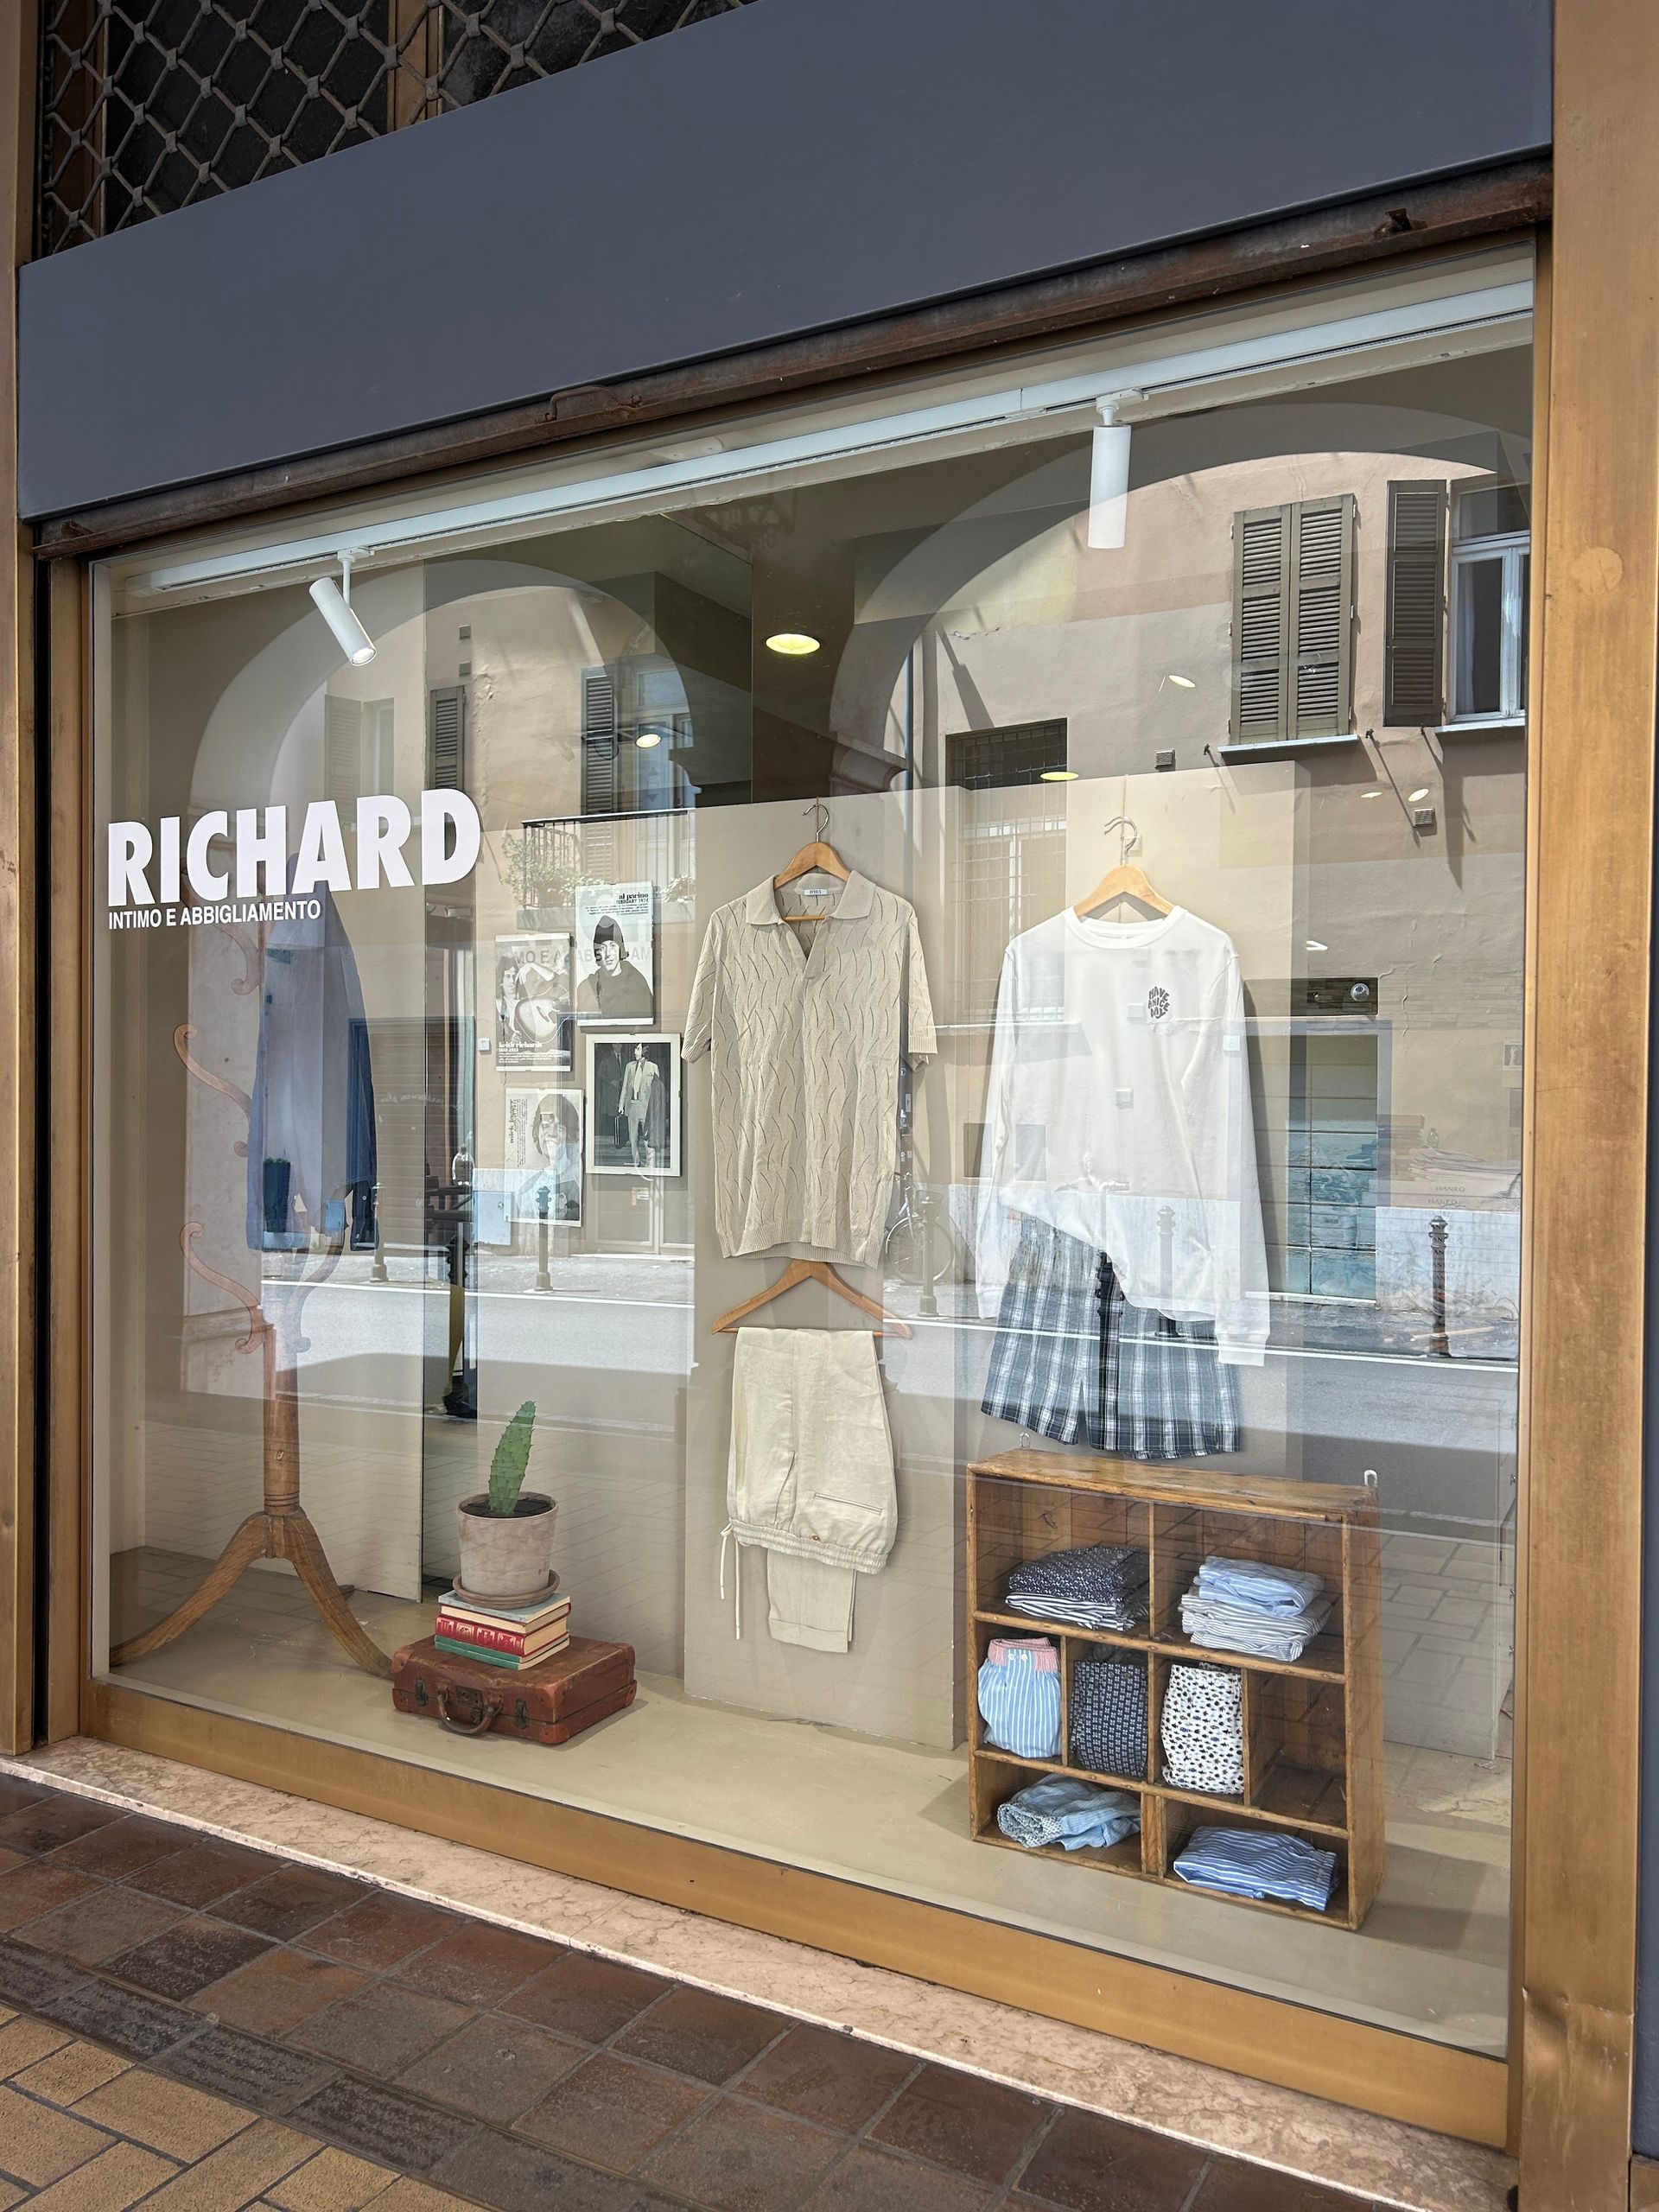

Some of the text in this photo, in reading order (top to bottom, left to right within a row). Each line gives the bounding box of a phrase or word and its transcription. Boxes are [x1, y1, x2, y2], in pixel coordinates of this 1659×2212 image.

[107, 788, 481, 906] RICHARD
[109, 899, 321, 930] INTIMO E ABBIGLIAMENTO
[1149, 986, 1170, 1001] HAVE
[1152, 997, 1170, 1012] NICE
[1150, 1006, 1166, 1019] DAY
